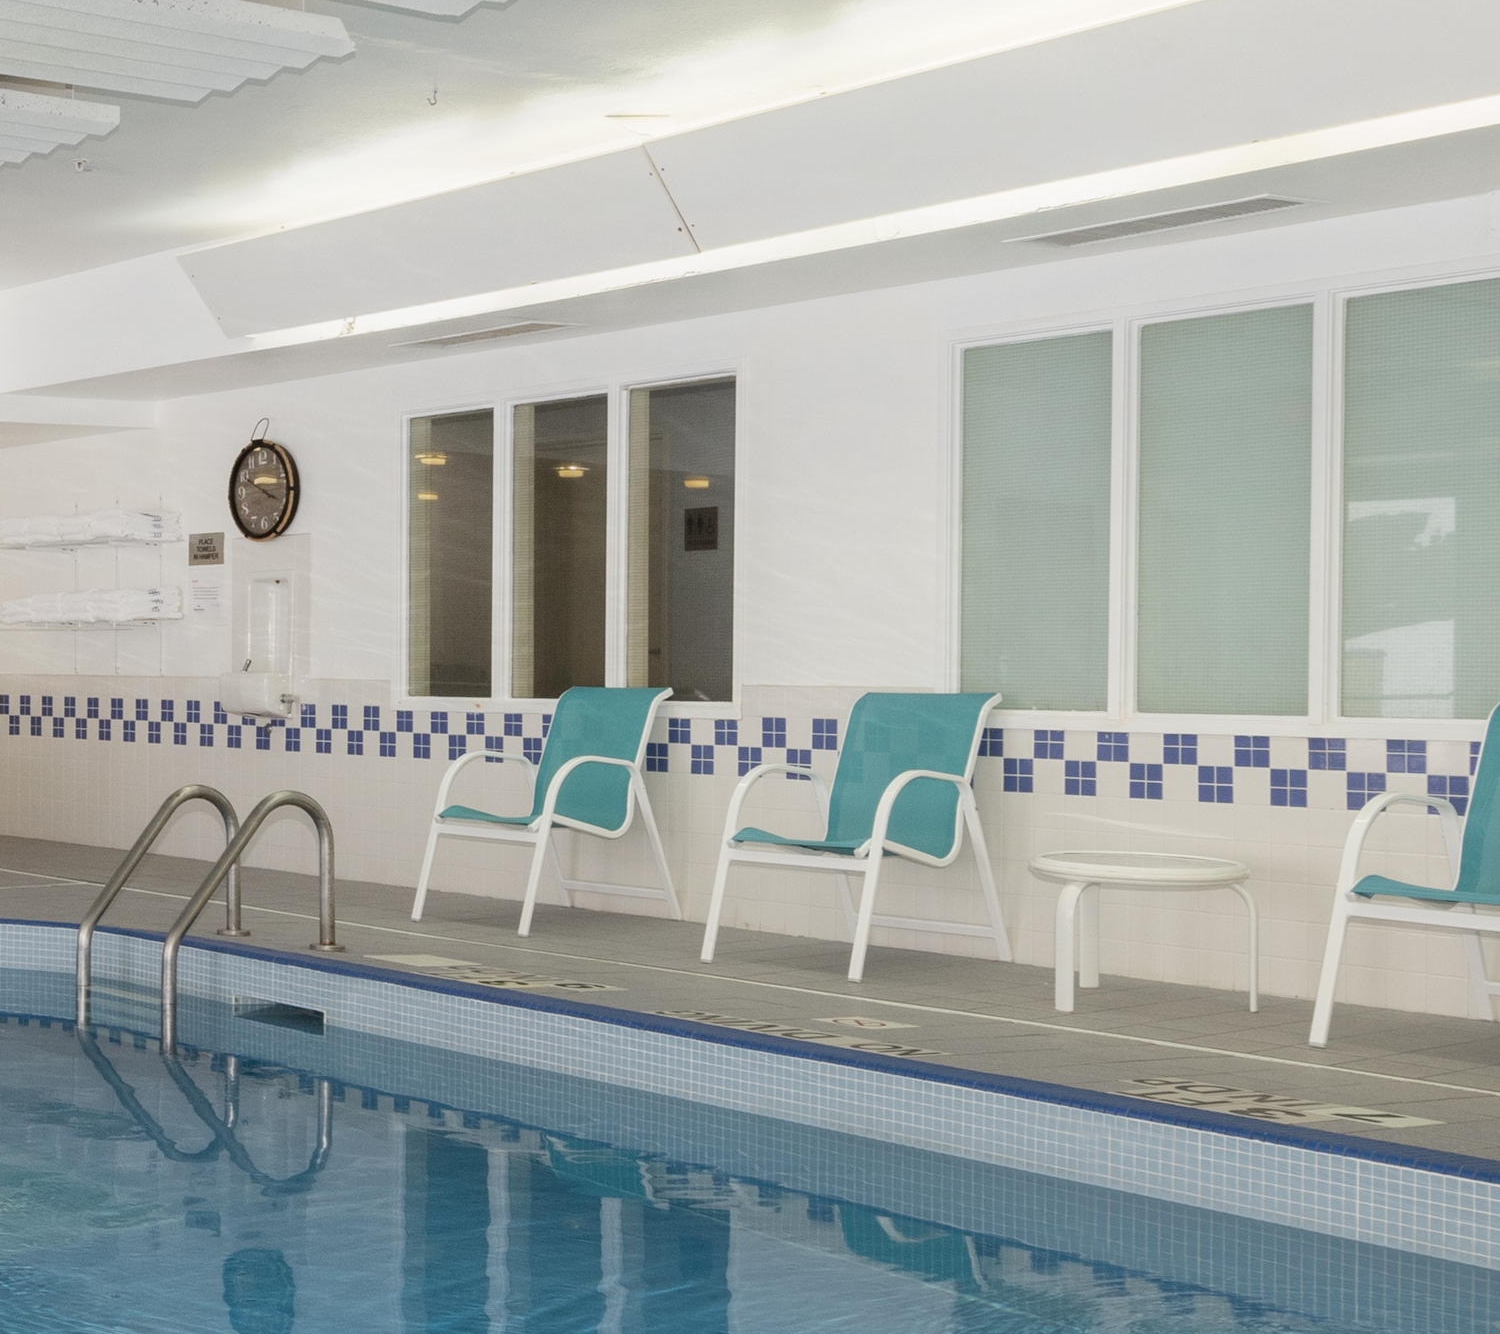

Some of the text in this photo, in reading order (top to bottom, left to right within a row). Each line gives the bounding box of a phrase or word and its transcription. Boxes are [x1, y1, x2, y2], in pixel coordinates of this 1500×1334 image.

[248, 455, 255, 469] 11
[240, 469, 249, 483] 10
[238, 486, 246, 500] 9
[241, 502, 249, 516] 8
[250, 515, 258, 528] 7
[260, 516, 269, 530] 6
[199, 552, 220, 560] HAMPER
[655, 1010, 945, 1056] NO DIVING
[1117, 1090, 1307, 1119] 3 FT
[1330, 1112, 1406, 1123] 7
